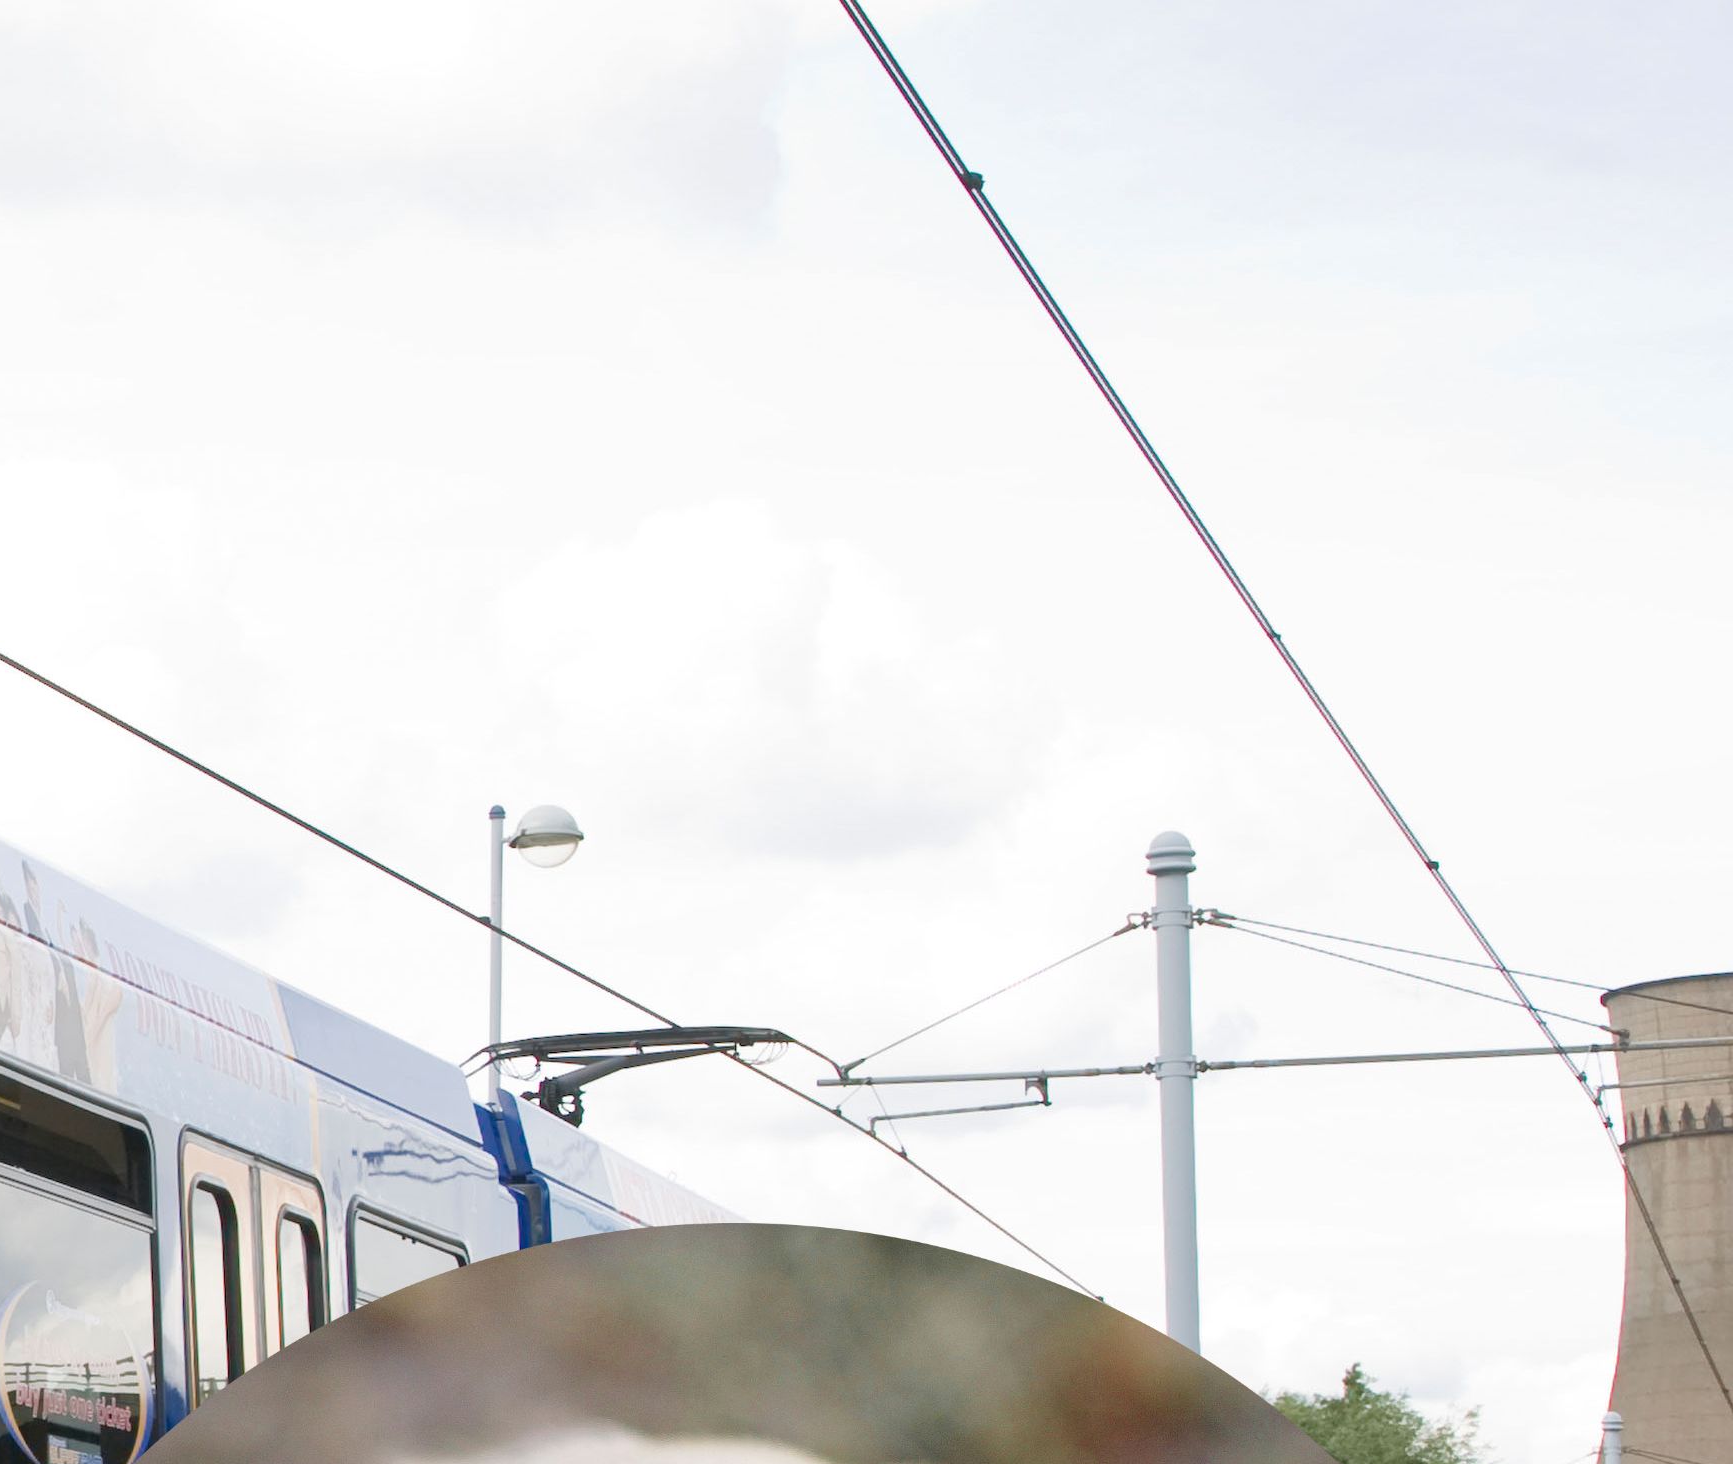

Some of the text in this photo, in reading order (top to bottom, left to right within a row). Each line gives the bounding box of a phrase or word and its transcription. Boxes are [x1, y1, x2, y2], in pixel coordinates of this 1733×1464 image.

[14, 1384, 133, 1433] buy just one ticket
